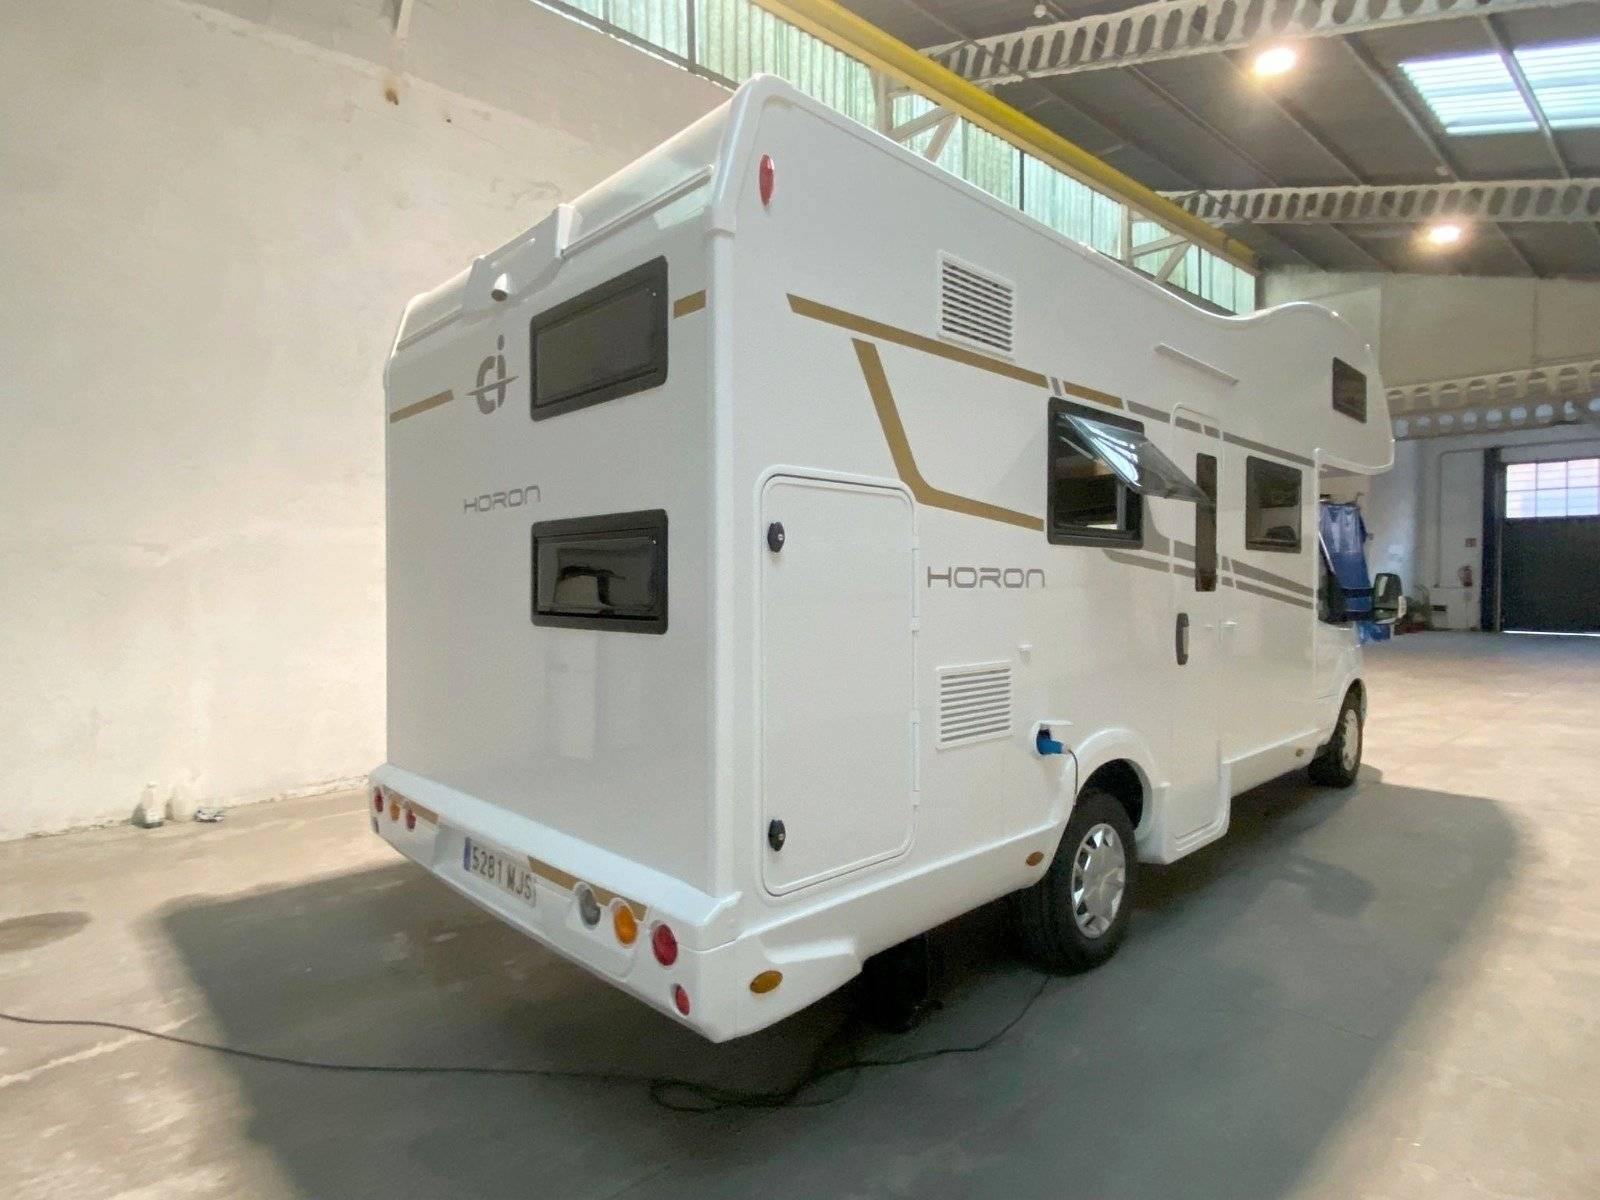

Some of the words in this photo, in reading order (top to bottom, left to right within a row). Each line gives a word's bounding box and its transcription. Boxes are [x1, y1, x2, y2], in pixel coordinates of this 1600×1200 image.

[463, 485, 541, 514] HORON
[927, 566, 1046, 589] HORON
[472, 846, 503, 883] 5281
[507, 864, 532, 900] MJS
